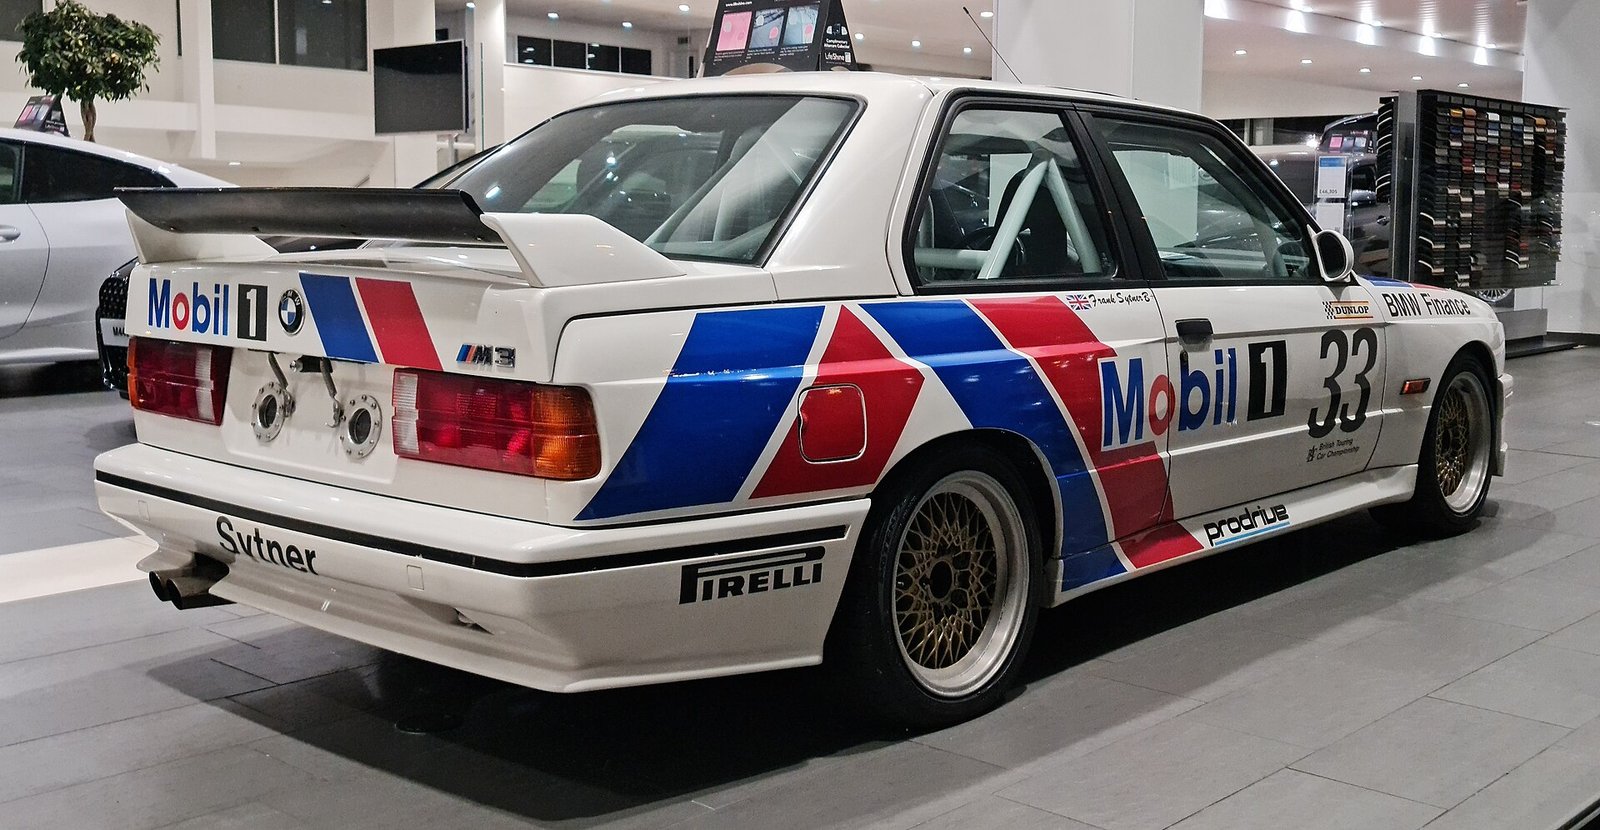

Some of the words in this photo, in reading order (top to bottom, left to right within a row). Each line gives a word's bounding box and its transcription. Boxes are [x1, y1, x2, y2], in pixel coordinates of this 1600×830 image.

[148, 277, 229, 336] Mobil
[1088, 294, 1116, 307] Frank
[1335, 305, 1369, 315] DUNLOP
[1381, 293, 1422, 317] BMW
[1420, 292, 1471, 316] Finance
[473, 344, 515, 368] M3
[1101, 348, 1236, 447] Mobil
[1308, 327, 1378, 438] 33
[1203, 504, 1289, 547] prodrive
[679, 546, 826, 605] PIRELLI
